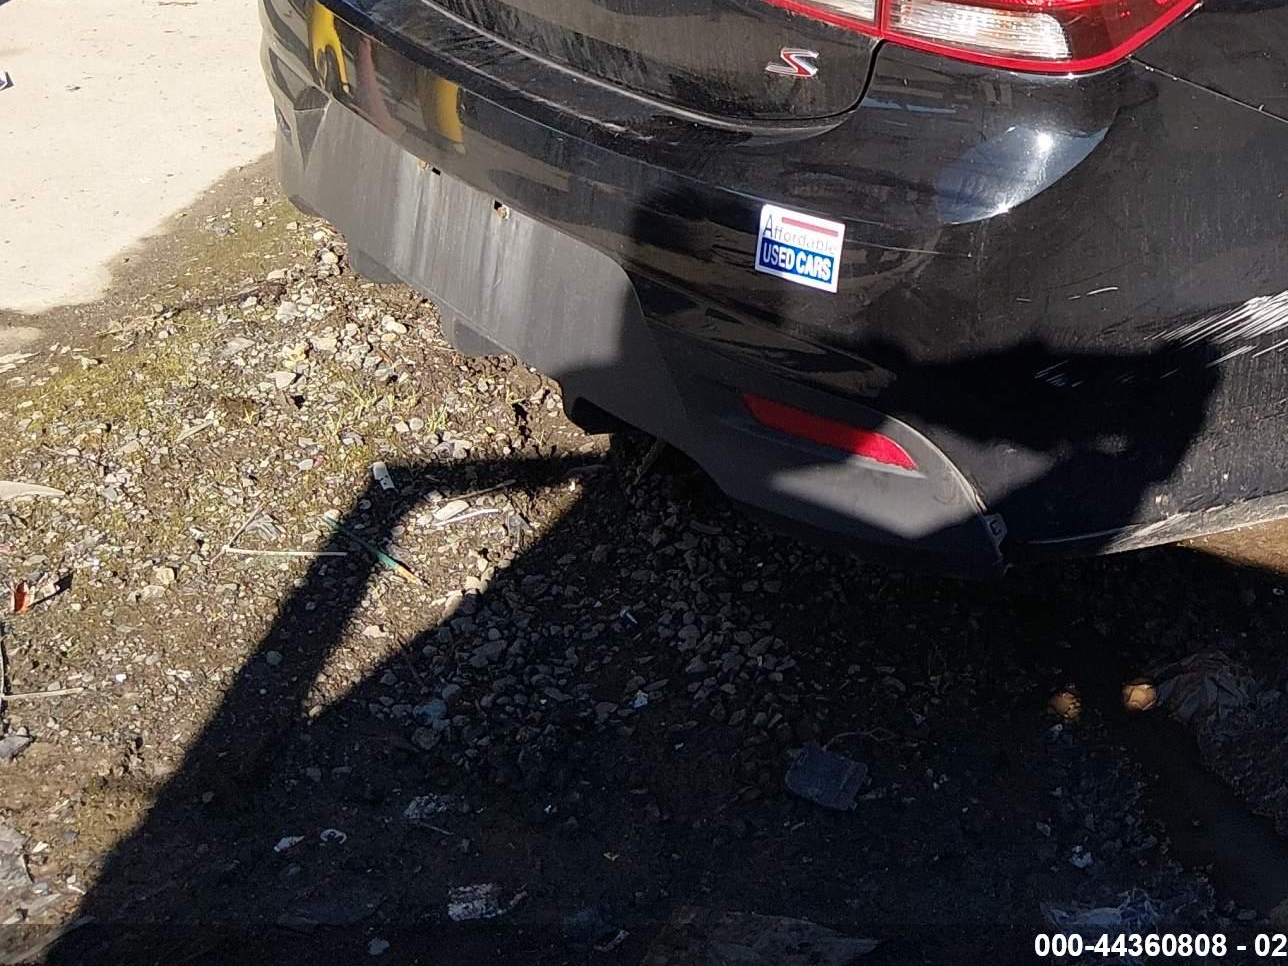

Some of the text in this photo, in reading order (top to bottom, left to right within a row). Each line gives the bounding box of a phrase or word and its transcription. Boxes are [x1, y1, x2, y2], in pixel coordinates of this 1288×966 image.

[765, 47, 819, 77] S
[763, 213, 837, 255] Affordable
[763, 242, 832, 282] USED CARS
